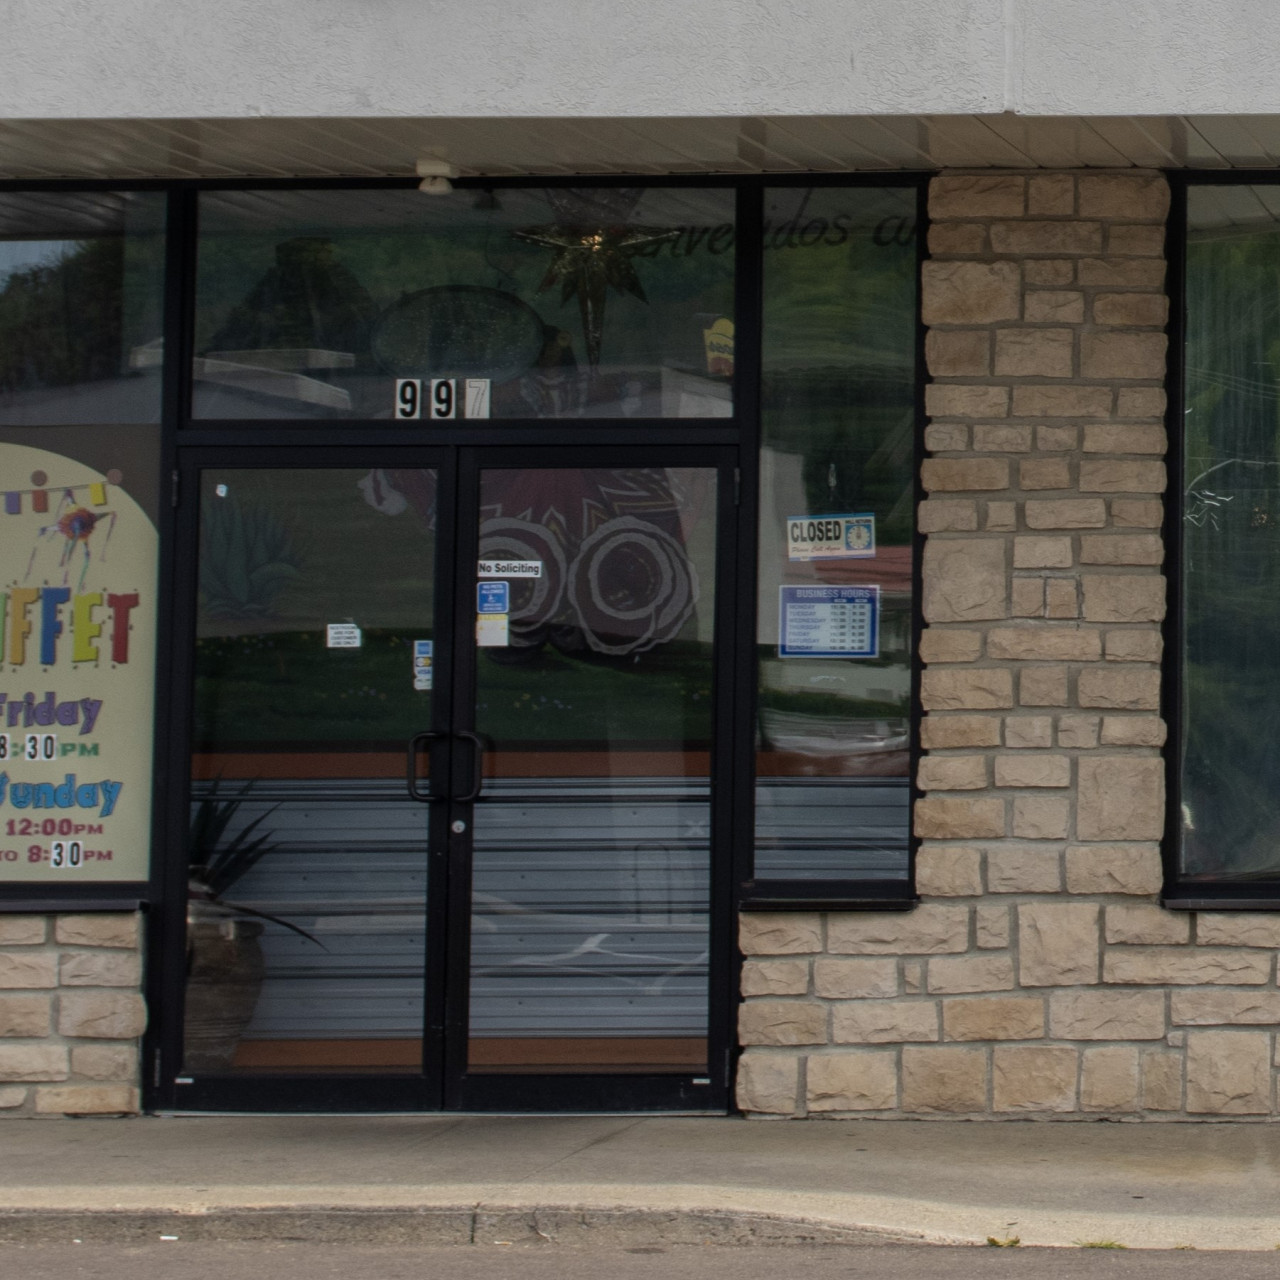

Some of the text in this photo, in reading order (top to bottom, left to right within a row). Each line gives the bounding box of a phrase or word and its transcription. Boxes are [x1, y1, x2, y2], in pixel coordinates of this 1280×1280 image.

[398, 380, 489, 418] 997
[790, 520, 842, 543] CLOSED
[479, 563, 539, 575] No Soliciting
[796, 589, 871, 598] BUSINESS HOURS
[0, 587, 140, 666] FFET
[6, 818, 104, 836] 12:00PM
